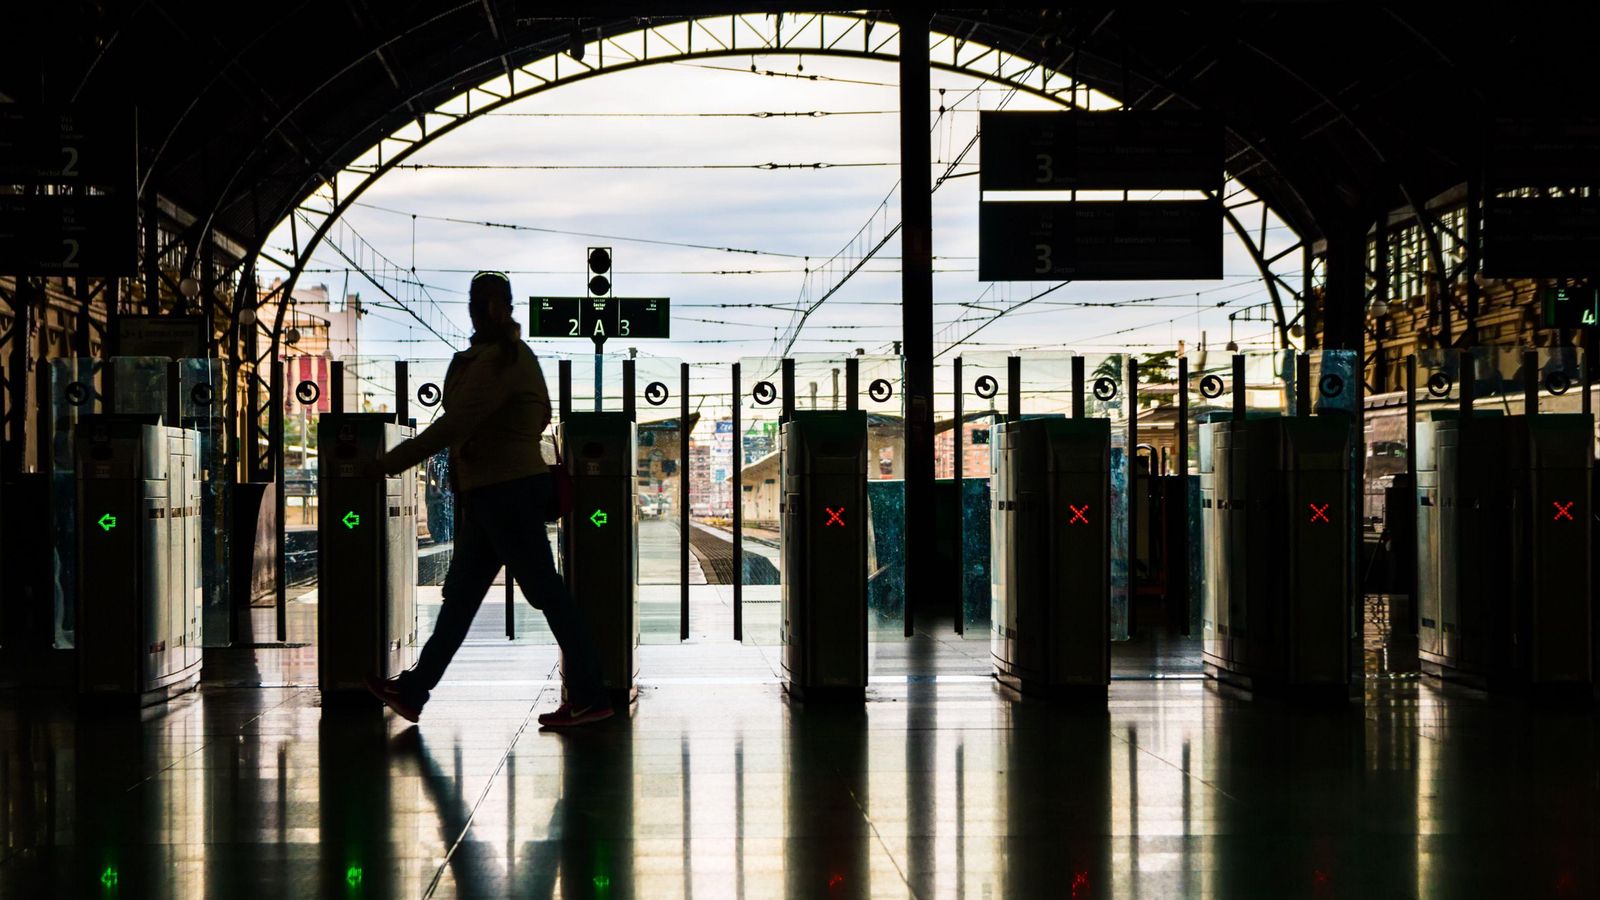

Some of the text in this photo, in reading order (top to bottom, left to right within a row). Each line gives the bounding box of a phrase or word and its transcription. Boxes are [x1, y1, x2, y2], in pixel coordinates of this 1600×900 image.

[61, 146, 79, 177] 2
[1034, 153, 1054, 184] 3
[62, 238, 80, 268] 2
[1033, 243, 1053, 275] 3
[568, 318, 579, 336] 2
[593, 319, 606, 337] A
[620, 319, 630, 337] 3
[1581, 308, 1595, 325] 4
